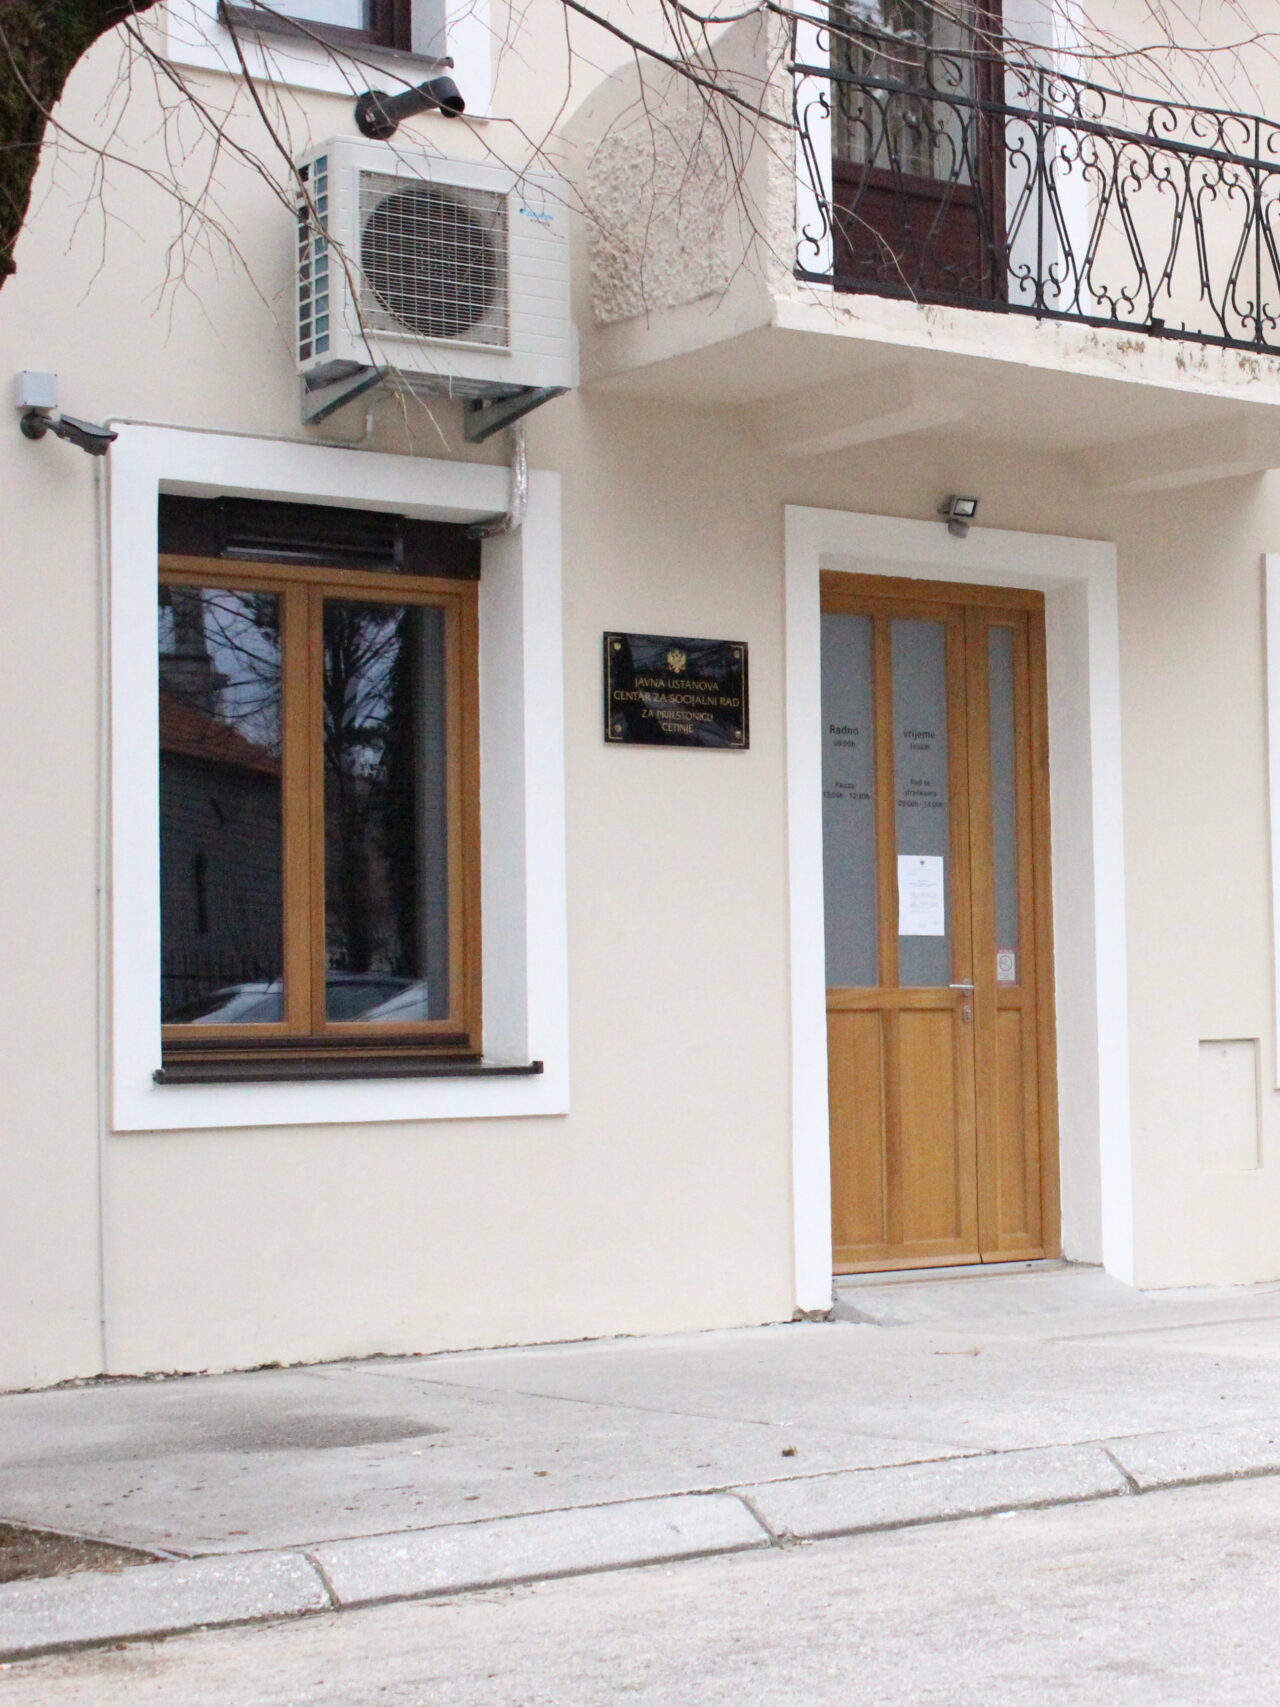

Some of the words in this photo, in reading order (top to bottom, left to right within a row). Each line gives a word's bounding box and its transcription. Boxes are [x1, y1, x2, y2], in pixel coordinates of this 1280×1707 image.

[635, 677, 665, 688] JAVNA
[668, 679, 719, 691] USTANOVA
[613, 690, 652, 701] CENTAR
[653, 693, 667, 703] ZA
[669, 694, 717, 707] SOCIJALNI
[719, 697, 740, 708] RAD
[641, 709, 653, 719] ZA
[829, 724, 859, 736] Radno
[903, 730, 936, 740] vrijeme
